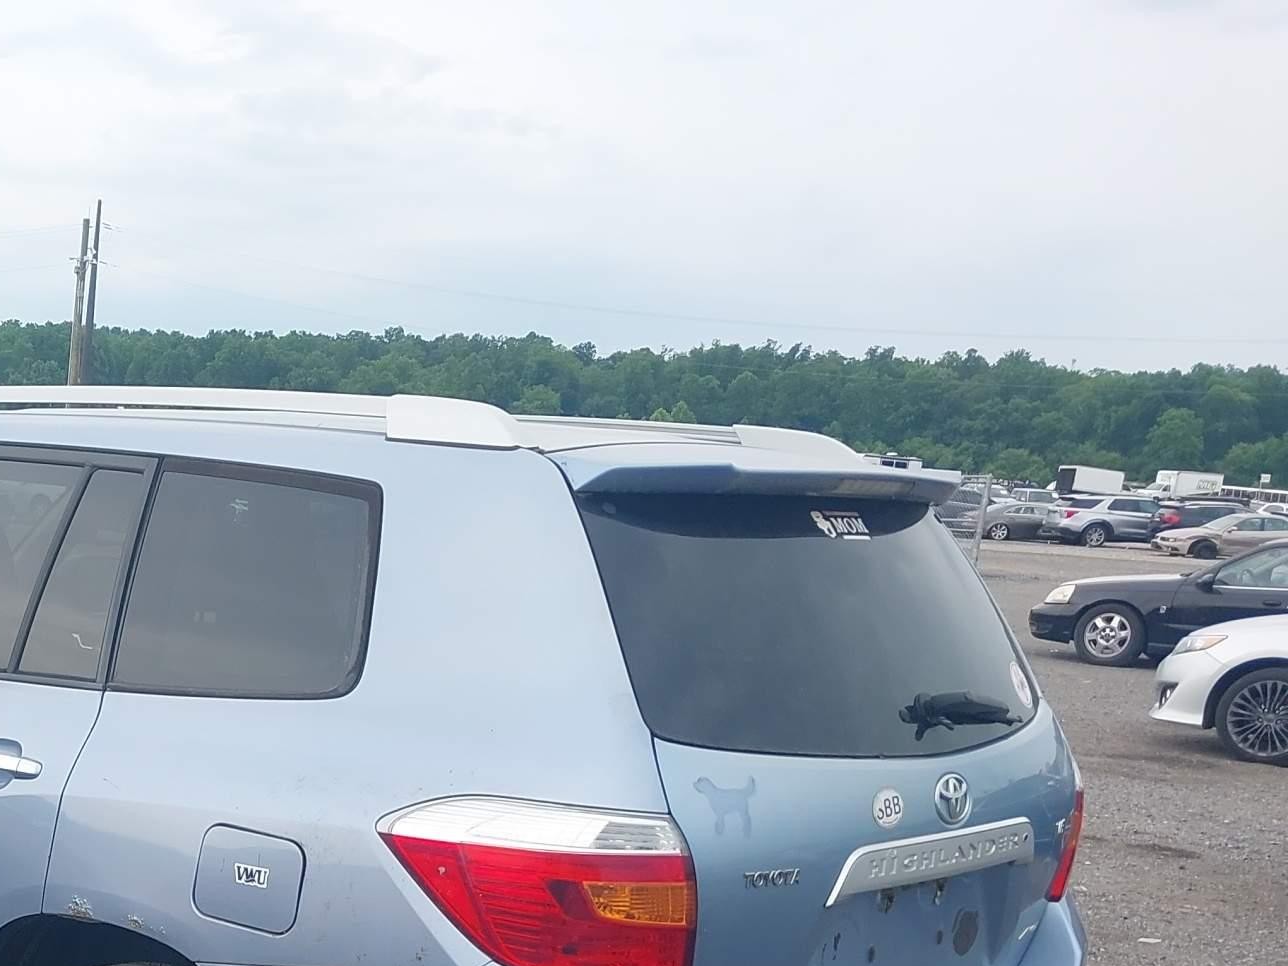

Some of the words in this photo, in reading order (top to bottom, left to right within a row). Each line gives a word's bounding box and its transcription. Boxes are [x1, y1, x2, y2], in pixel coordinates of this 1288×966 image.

[829, 516, 870, 534] MOM
[868, 832, 1020, 879] HIGHLANDER
[743, 868, 801, 889] TOYOTA
